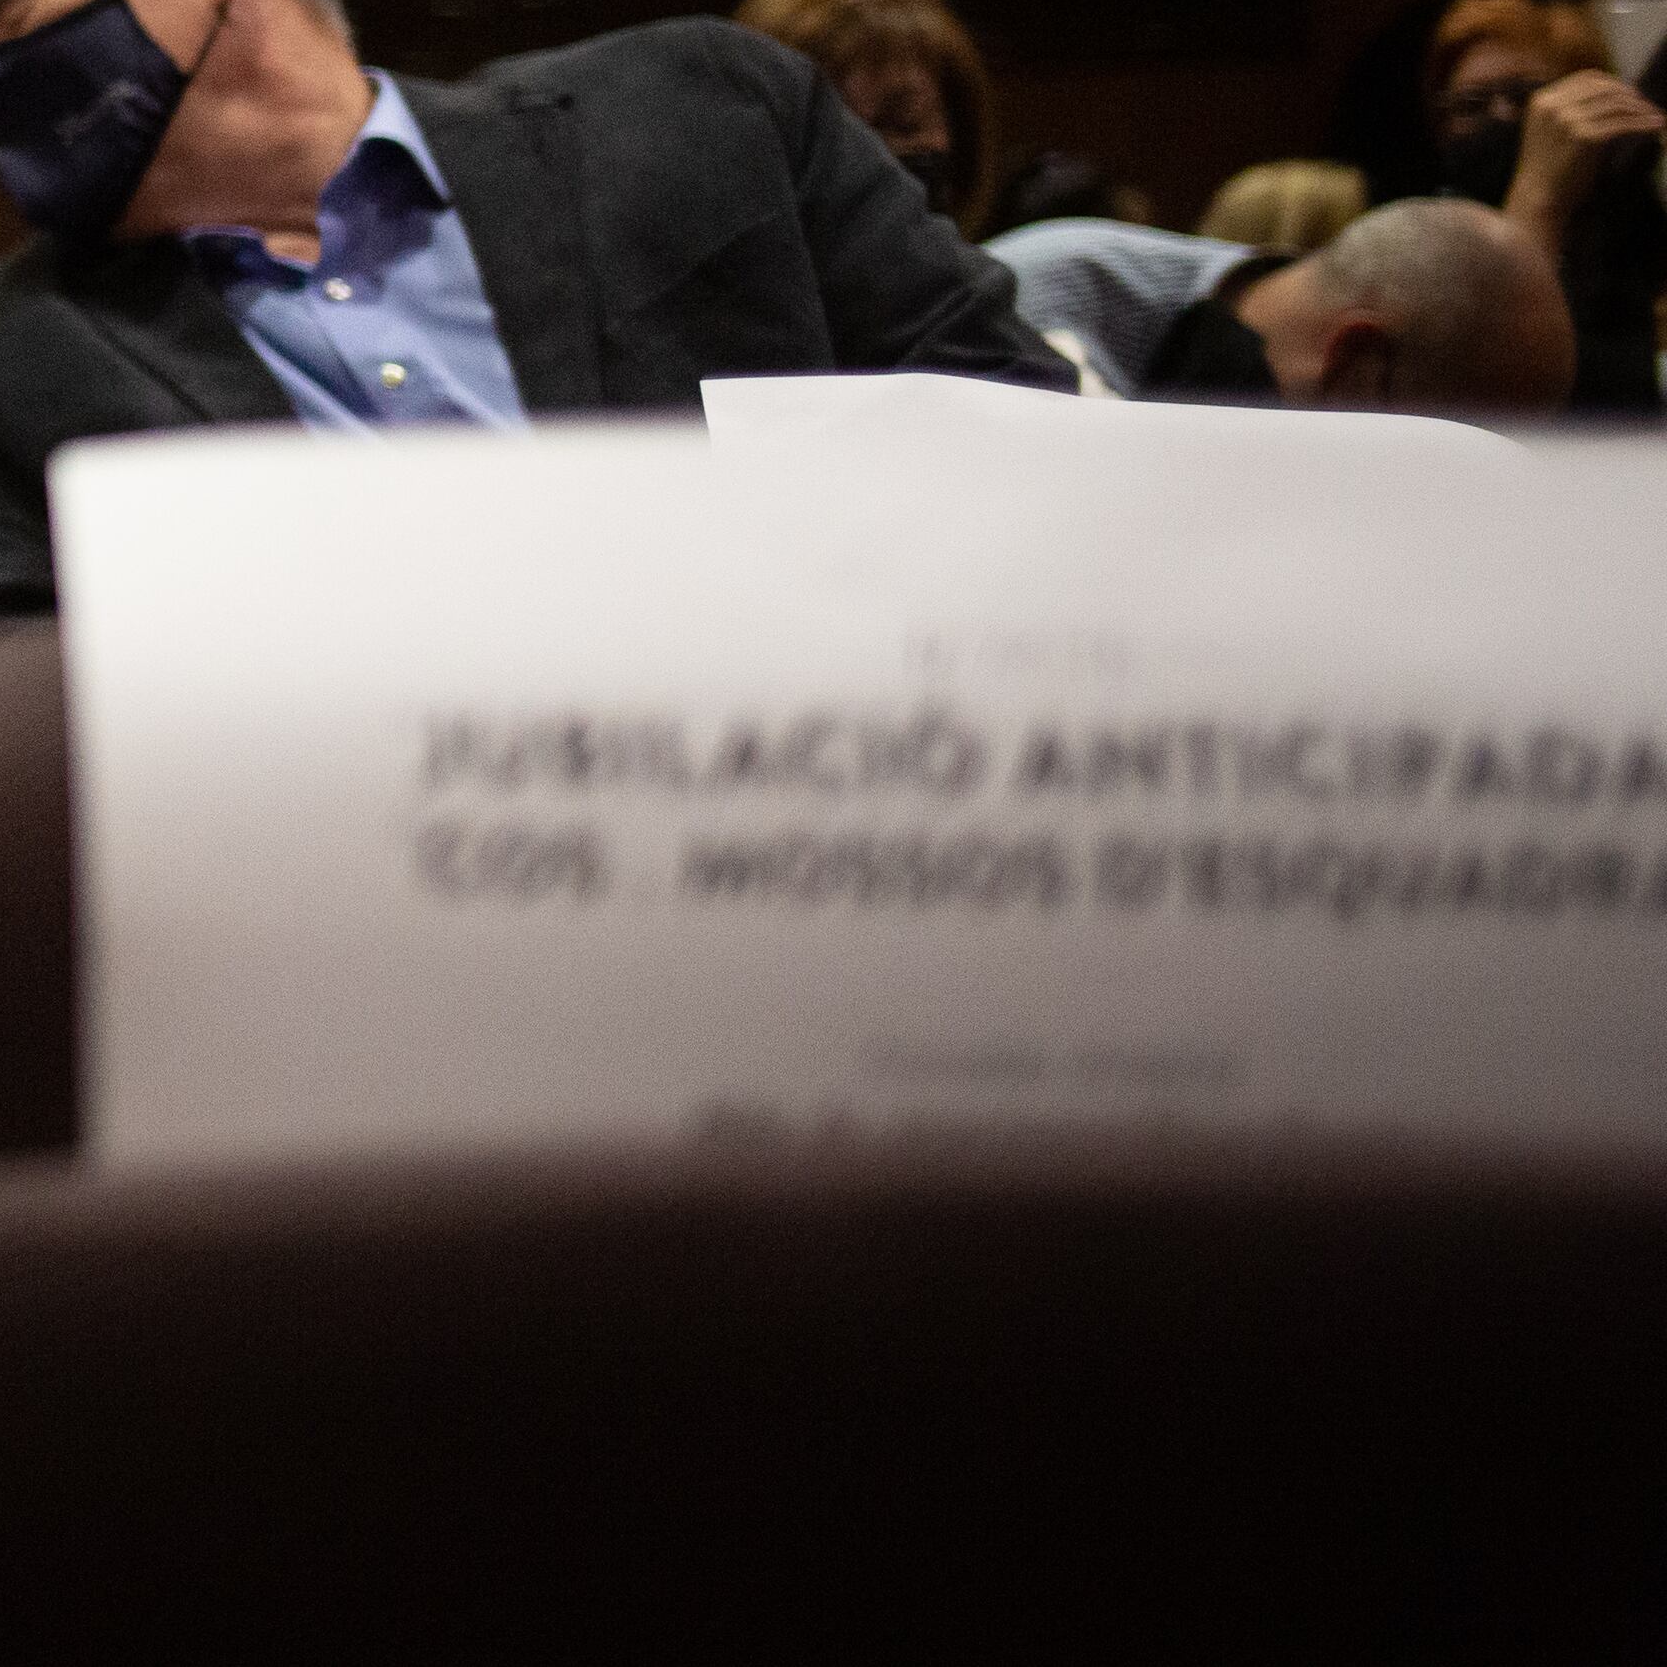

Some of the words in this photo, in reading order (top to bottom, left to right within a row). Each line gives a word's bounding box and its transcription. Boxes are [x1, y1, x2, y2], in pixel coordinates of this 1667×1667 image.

[415, 695, 987, 798] JUBILACIÓ
[1010, 719, 1667, 806] ANTICIPADA
[413, 818, 609, 905] COS
[675, 828, 1069, 913] MOSSOS
